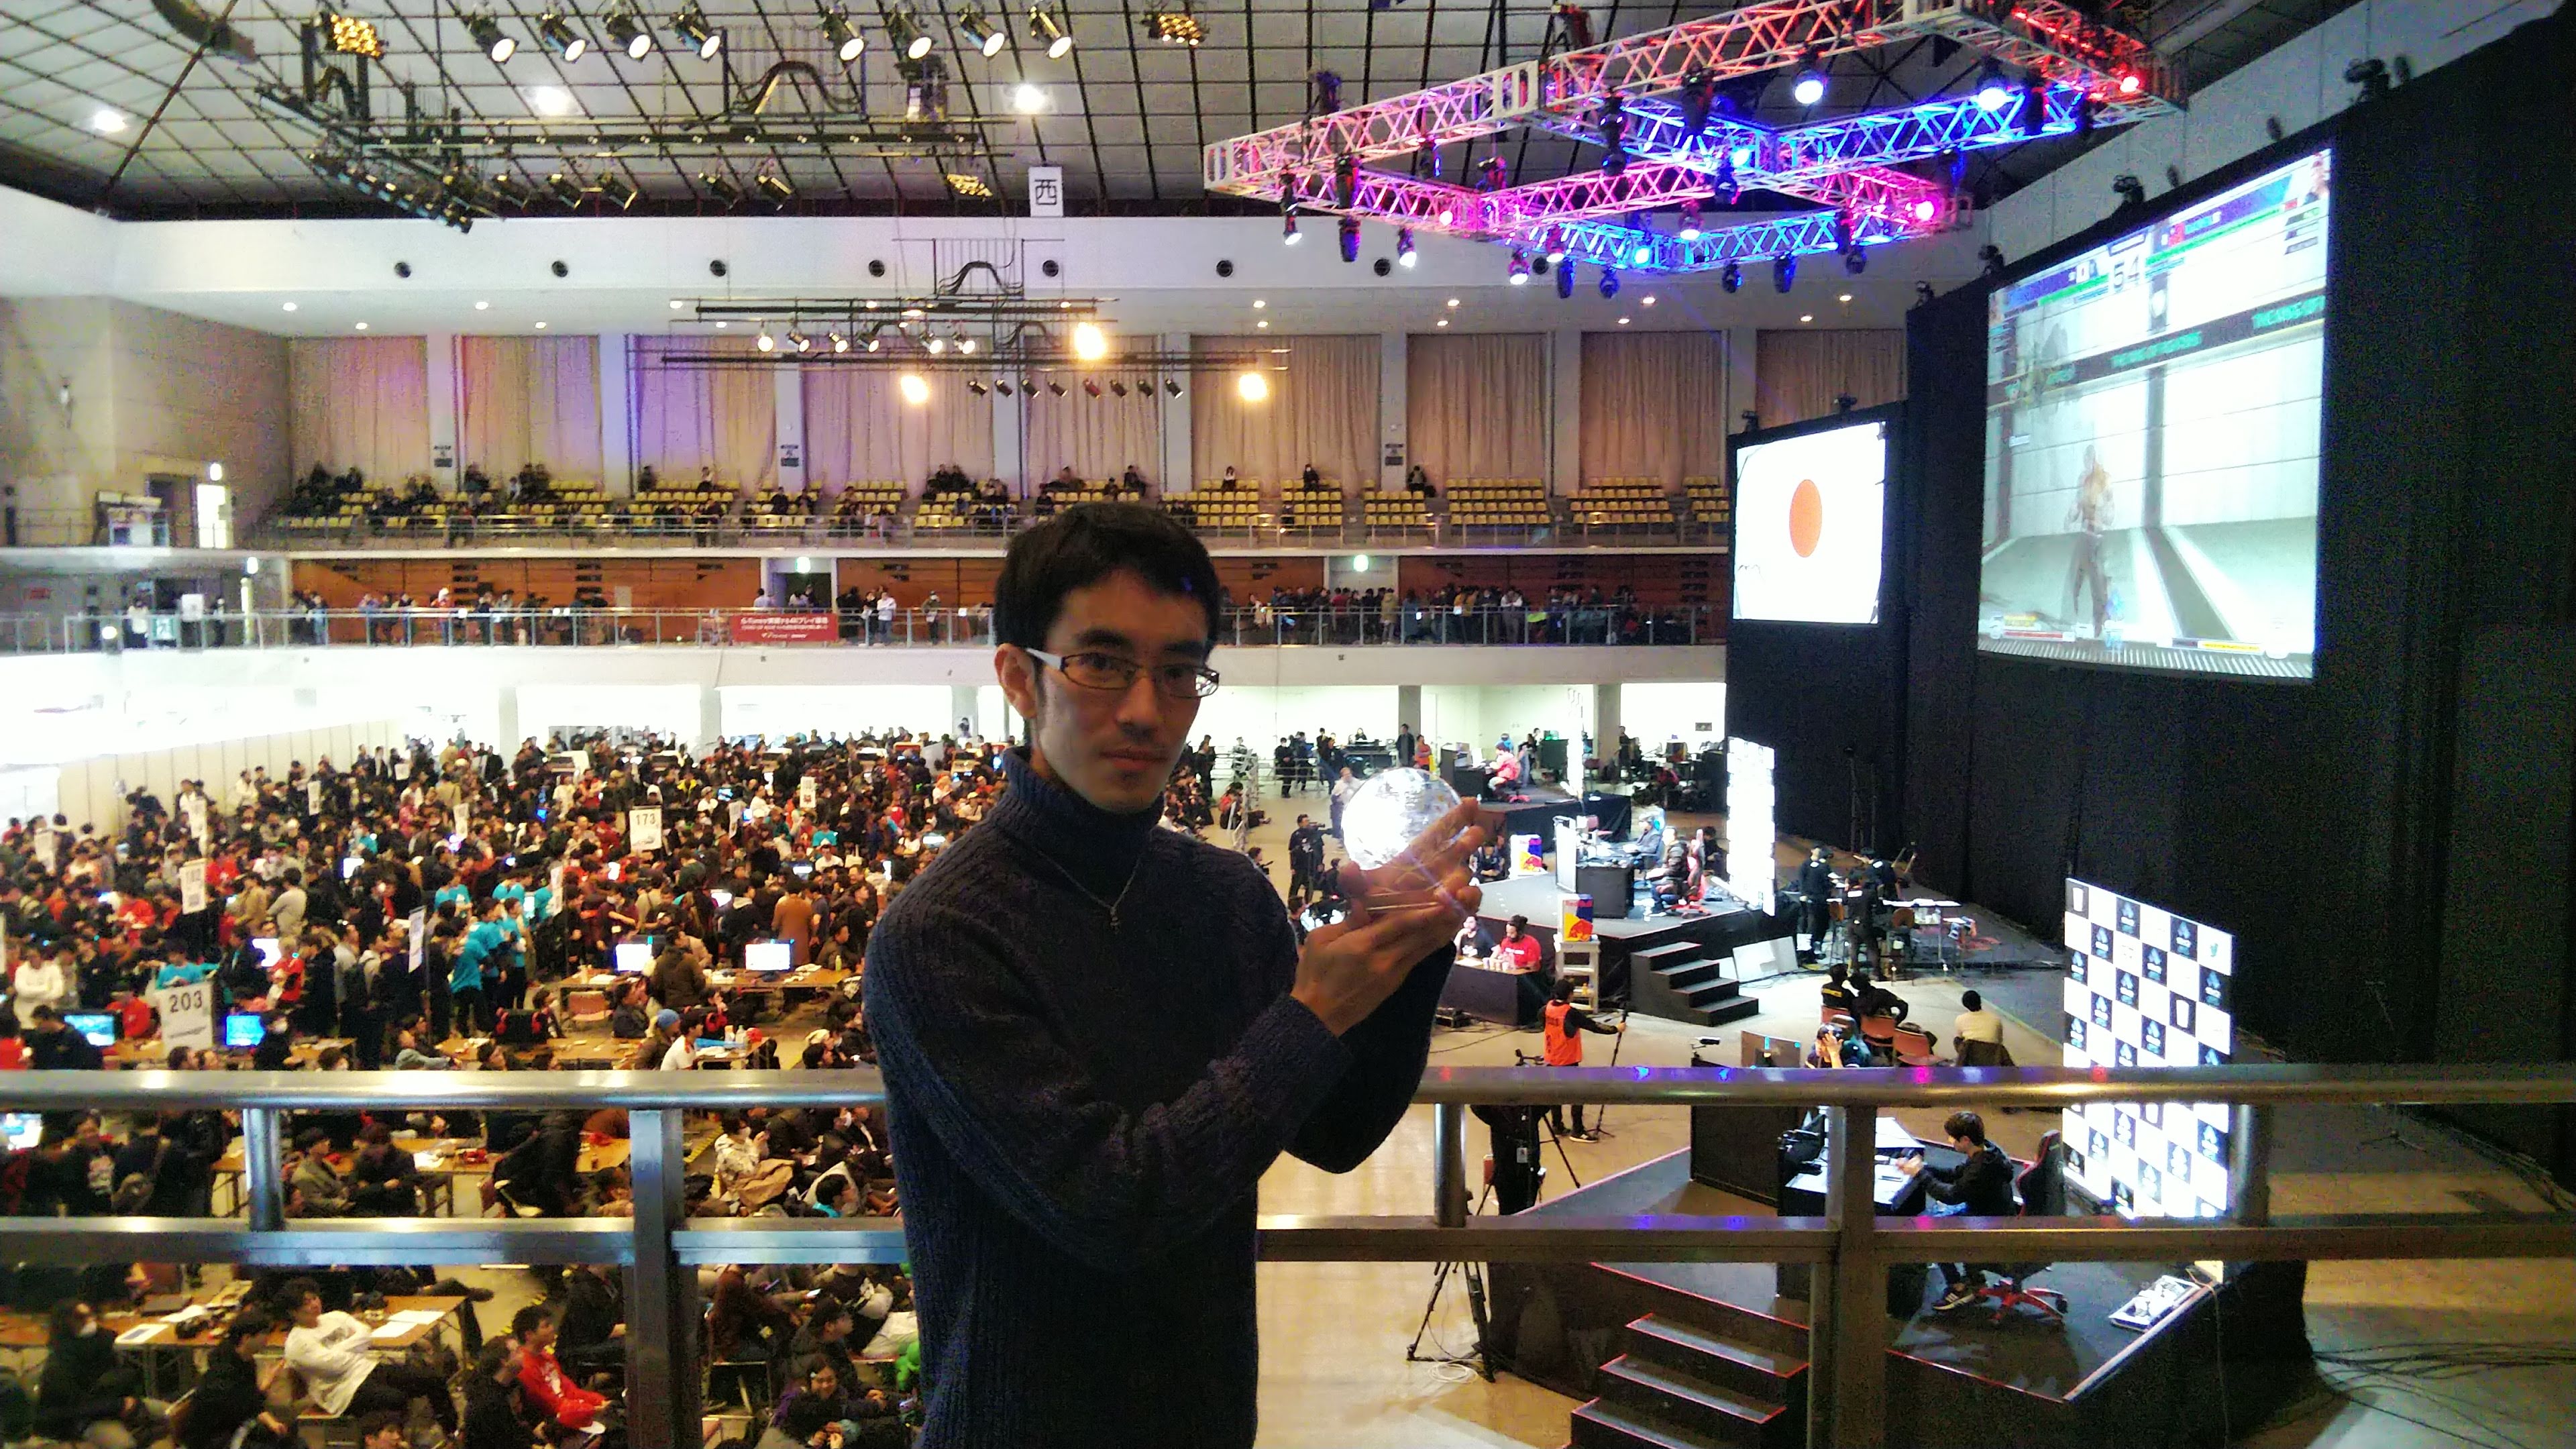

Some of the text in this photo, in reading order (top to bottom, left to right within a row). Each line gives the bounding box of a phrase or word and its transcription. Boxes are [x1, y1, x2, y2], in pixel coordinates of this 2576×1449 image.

[1034, 178, 1058, 206] 西
[635, 813, 657, 826] 173
[168, 990, 203, 1013] 203
